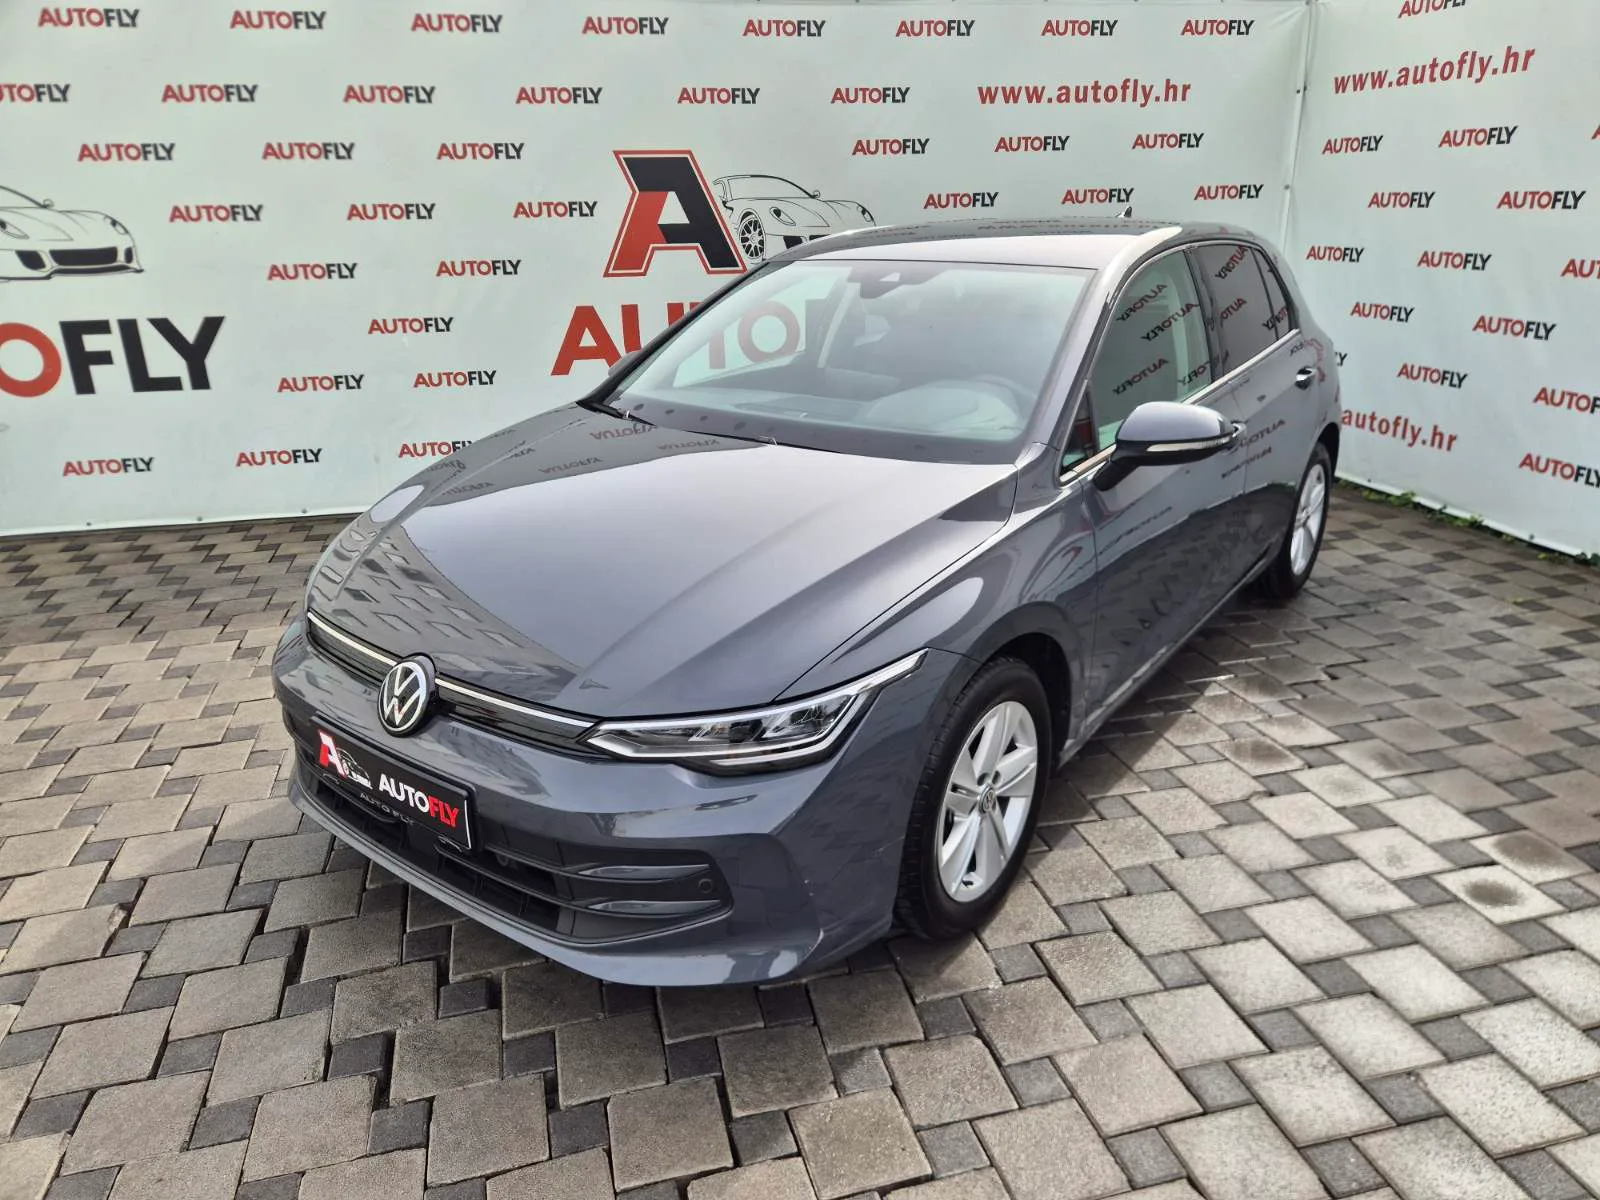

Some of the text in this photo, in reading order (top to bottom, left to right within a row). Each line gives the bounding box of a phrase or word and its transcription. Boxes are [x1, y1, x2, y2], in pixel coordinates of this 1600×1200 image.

[38, 8, 140, 28] AUTOFLY
[230, 10, 326, 30] AUTOFLY
[411, 13, 503, 33] AUTOFLY
[582, 16, 669, 35] AUTOFLY
[742, 19, 826, 37] AUTOFLY
[896, 20, 975, 37] AUTOFLY
[1041, 20, 1118, 36] AUTOFLY
[1180, 20, 1255, 36] AUTOFLY
[1334, 46, 1535, 94] www.autofly.hr
[161, 84, 258, 103] AUTOFLY
[343, 85, 436, 104] AUTOFLY
[516, 87, 602, 104] AUTOFLY
[677, 87, 760, 104] AUTOFLY
[830, 87, 910, 104] AUTOFLY
[977, 78, 1191, 108] www.autofly.hr
[994, 136, 1070, 152] AUTOFLY
[1132, 133, 1204, 149] AUTOFLY
[1322, 135, 1383, 154] AUTOFLY
[1438, 125, 1518, 148] AUTOFLY
[78, 143, 175, 162] AUTOFLY
[262, 142, 355, 160] AUTOFLY
[437, 143, 525, 160] AUTOFLY
[852, 138, 930, 156] AUTOFLY
[923, 192, 999, 209] AUTOFLY
[1061, 188, 1134, 205] AUTOFLY
[1194, 184, 1264, 200] AUTOFLY
[1368, 192, 1436, 208] AUTOFLY
[1496, 190, 1586, 209] AUTOFLY
[169, 204, 263, 223] AUTOFLY
[347, 203, 436, 221] AUTOFLY
[513, 201, 598, 218] AUTOFLY
[603, 149, 748, 277] A
[1306, 246, 1364, 263] AUTOFLY
[1417, 251, 1492, 271] AUTOFLY
[267, 263, 358, 281] AUTOFLY
[436, 259, 521, 277] AUTOFLY
[1350, 302, 1415, 323] AUTOFLY
[368, 317, 454, 334] AUTOFLY
[1472, 315, 1556, 341] AUTOFLY
[0, 316, 226, 398] OFLY
[277, 374, 364, 393] AUTOFLY
[413, 368, 496, 388] AUTOFLY
[1397, 363, 1468, 389] AUTOFLY
[236, 448, 322, 467] AUTOFLY
[398, 441, 472, 458] AUTOF
[63, 457, 154, 476] AUTOFLY
[378, 773, 460, 829] AUTOFLY
